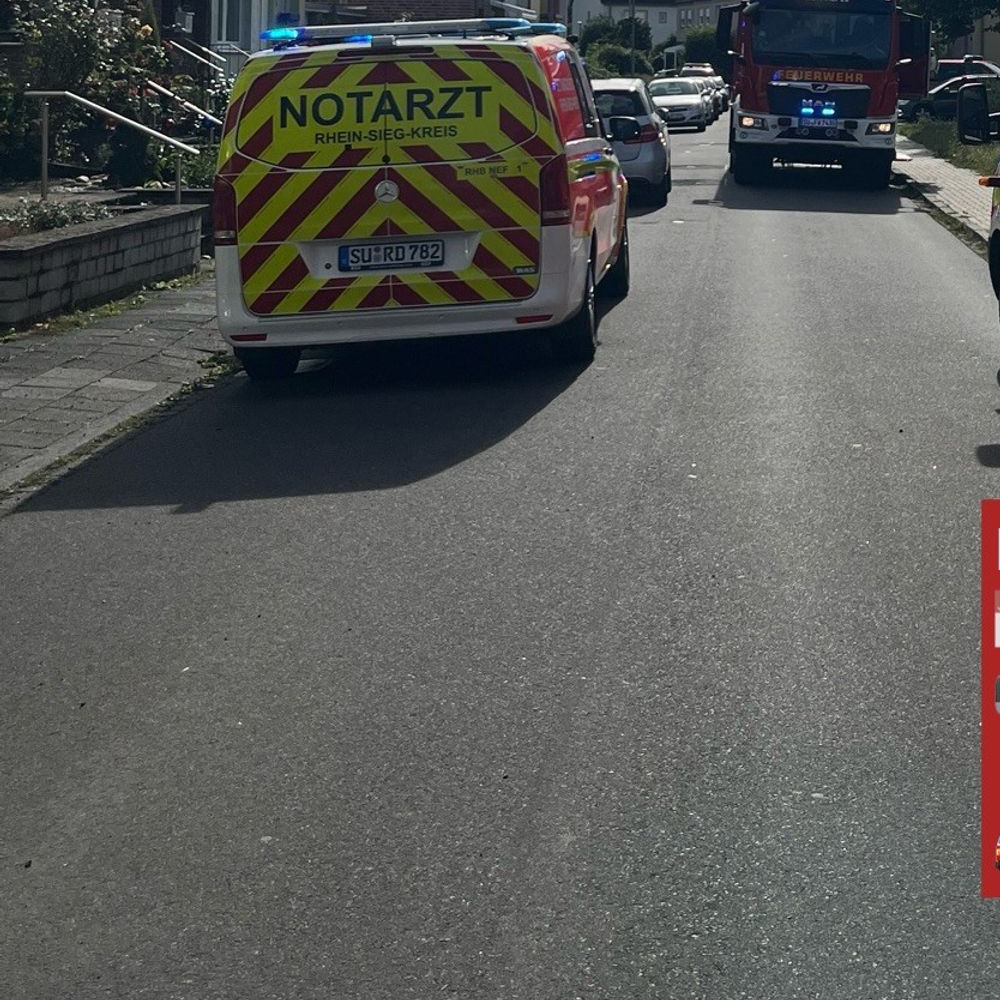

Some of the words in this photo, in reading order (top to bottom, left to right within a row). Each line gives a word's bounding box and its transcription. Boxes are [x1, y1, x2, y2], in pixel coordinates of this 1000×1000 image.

[777, 71, 864, 84] FEUERWEHR
[280, 86, 492, 129] NOTARZT
[315, 125, 458, 145] RHEIN-SIEG-KREIS
[464, 167, 487, 176] RHB
[489, 165, 508, 175] NEF
[350, 247, 372, 264] SU
[384, 245, 406, 262] RD
[409, 243, 440, 260] 782
